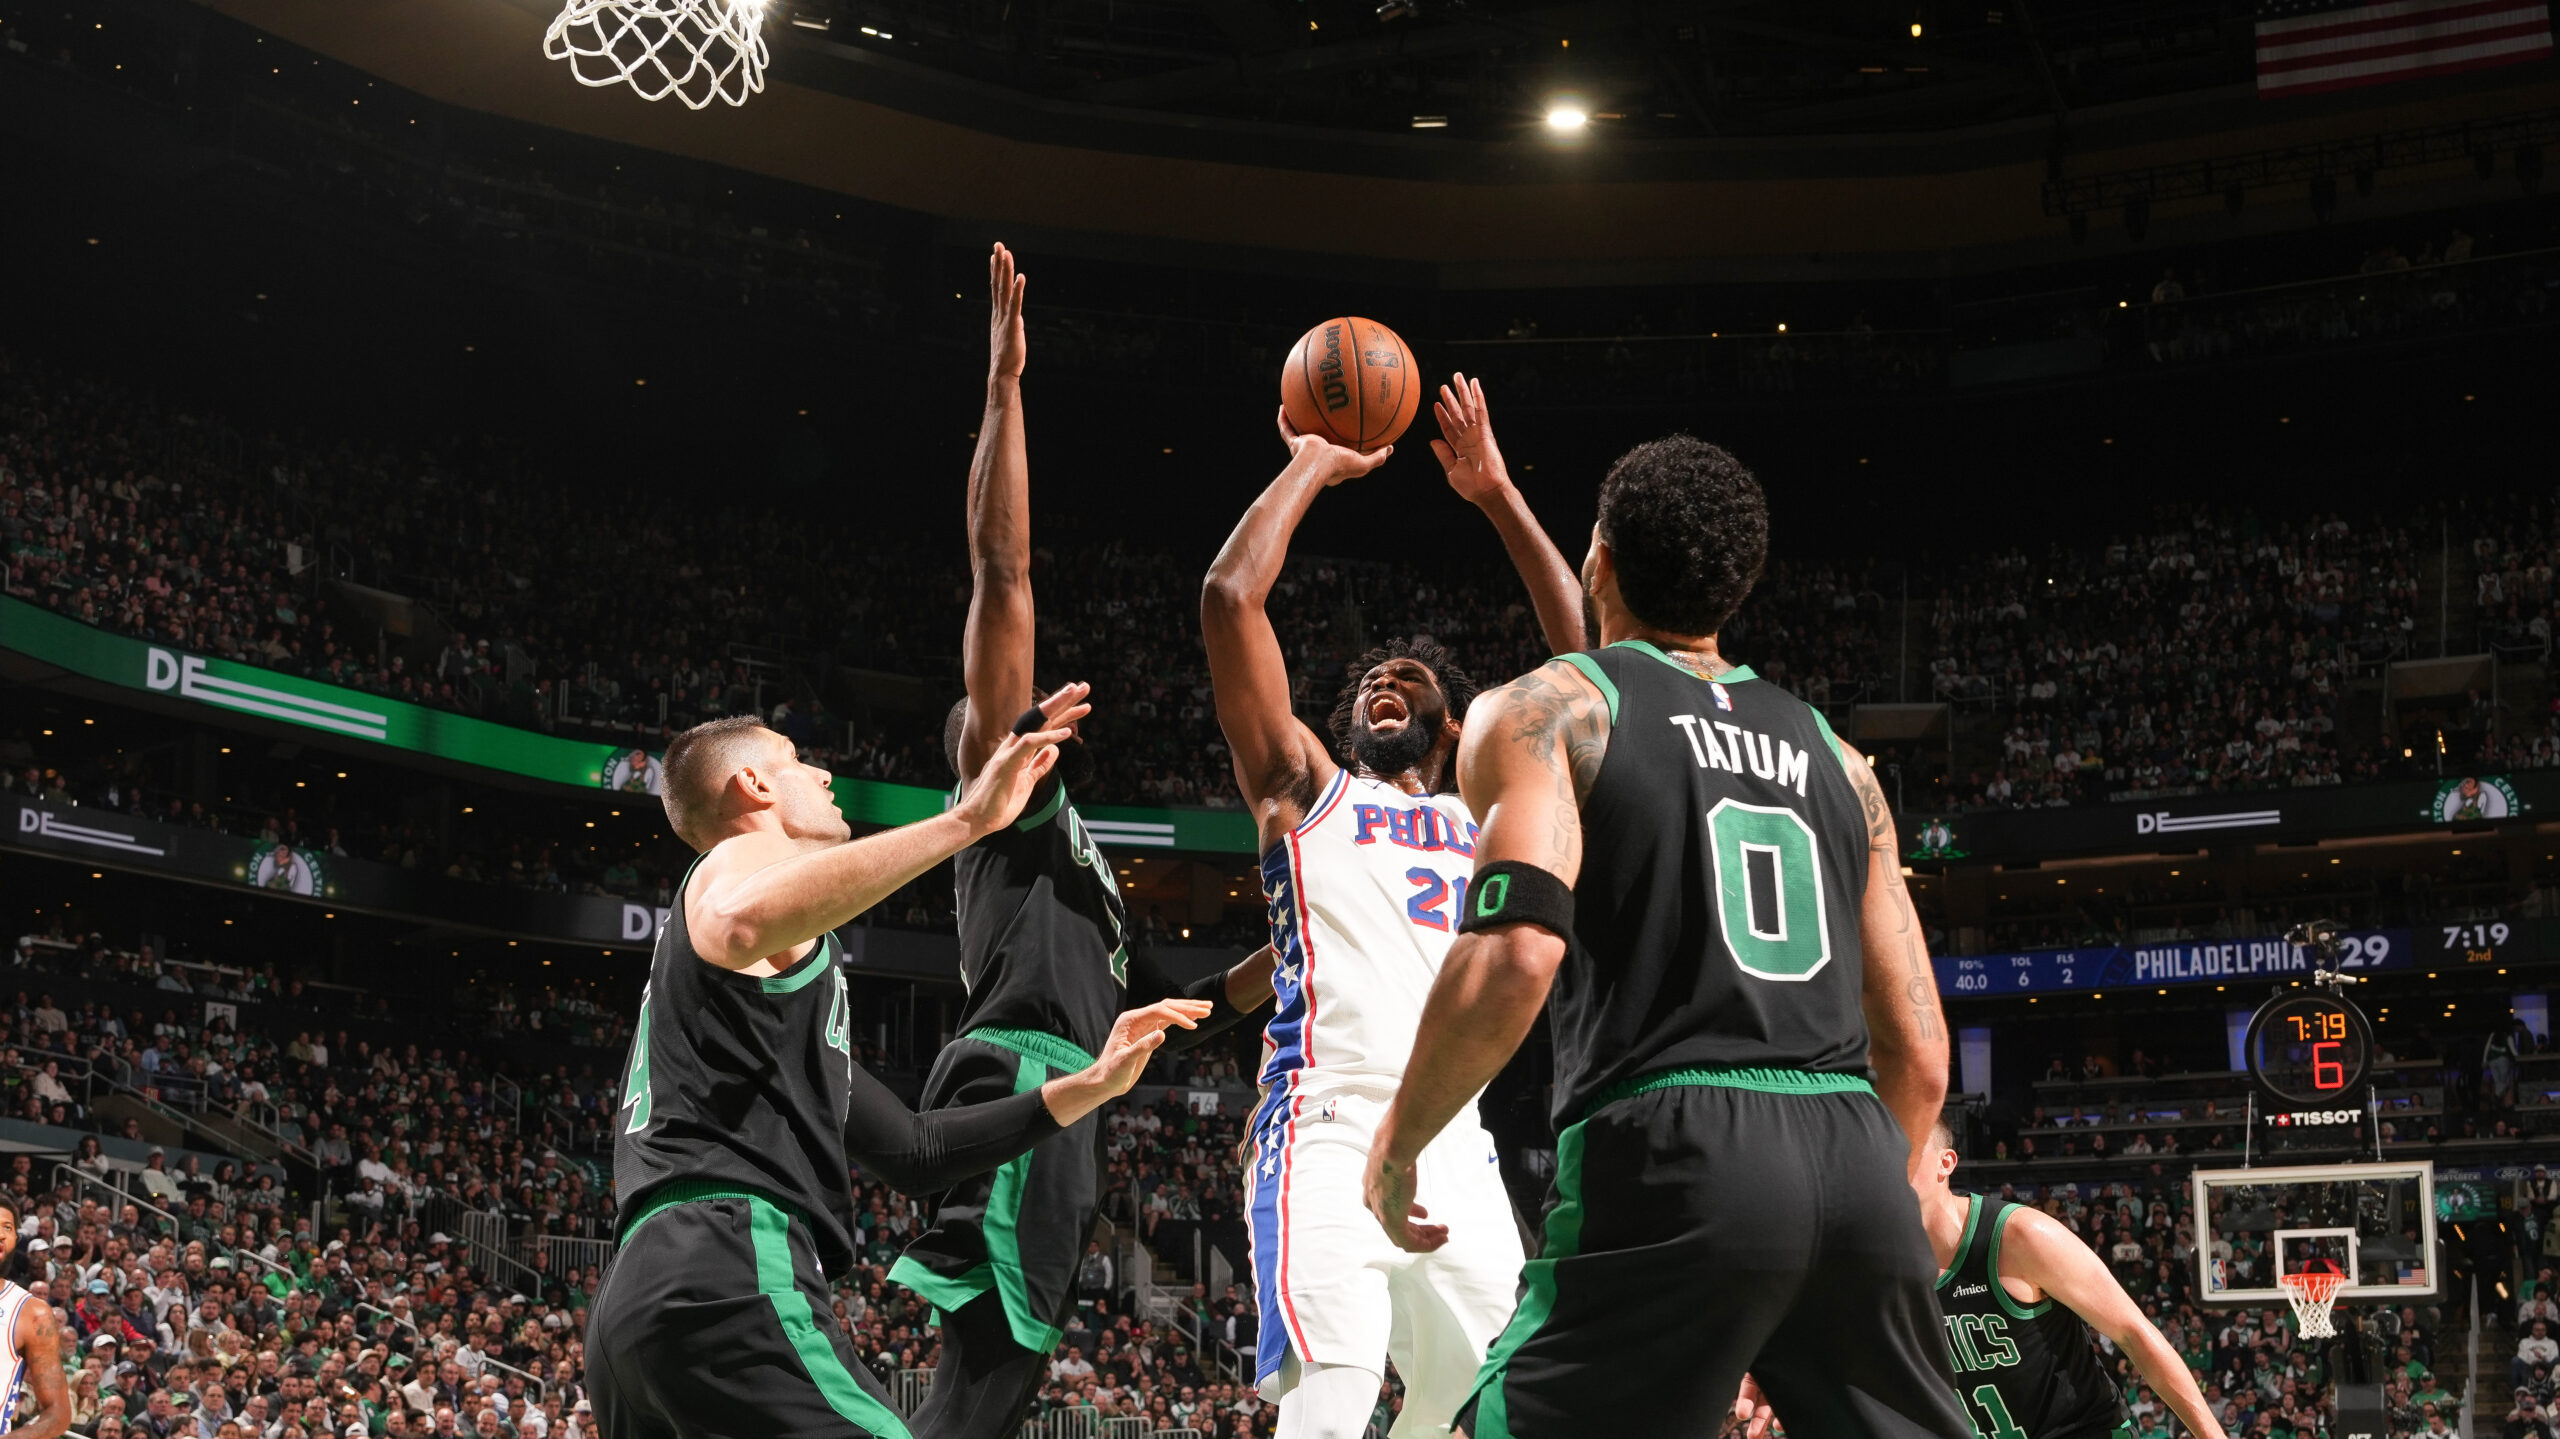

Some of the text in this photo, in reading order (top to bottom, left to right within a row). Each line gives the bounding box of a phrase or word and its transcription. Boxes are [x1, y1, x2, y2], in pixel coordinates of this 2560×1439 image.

[1318, 323, 1350, 413] Wilson
[1669, 714, 1809, 798] TATUM
[1477, 873, 1511, 917] 0
[1706, 797, 1832, 982] 0
[2443, 922, 2510, 949] 7:19
[1959, 954, 2075, 971] FG% TOL FLS
[2135, 940, 2307, 980] PHILADELPHIA
[2341, 935, 2390, 968] 29
[2467, 948, 2492, 963] 2nd
[1955, 968, 2073, 991] 40.0 6 2
[2287, 1013, 2346, 1041] 7:19
[2312, 1041, 2344, 1090] 6
[2290, 1108, 2362, 1127] TISSOT
[1952, 1283, 1988, 1298] Amica
